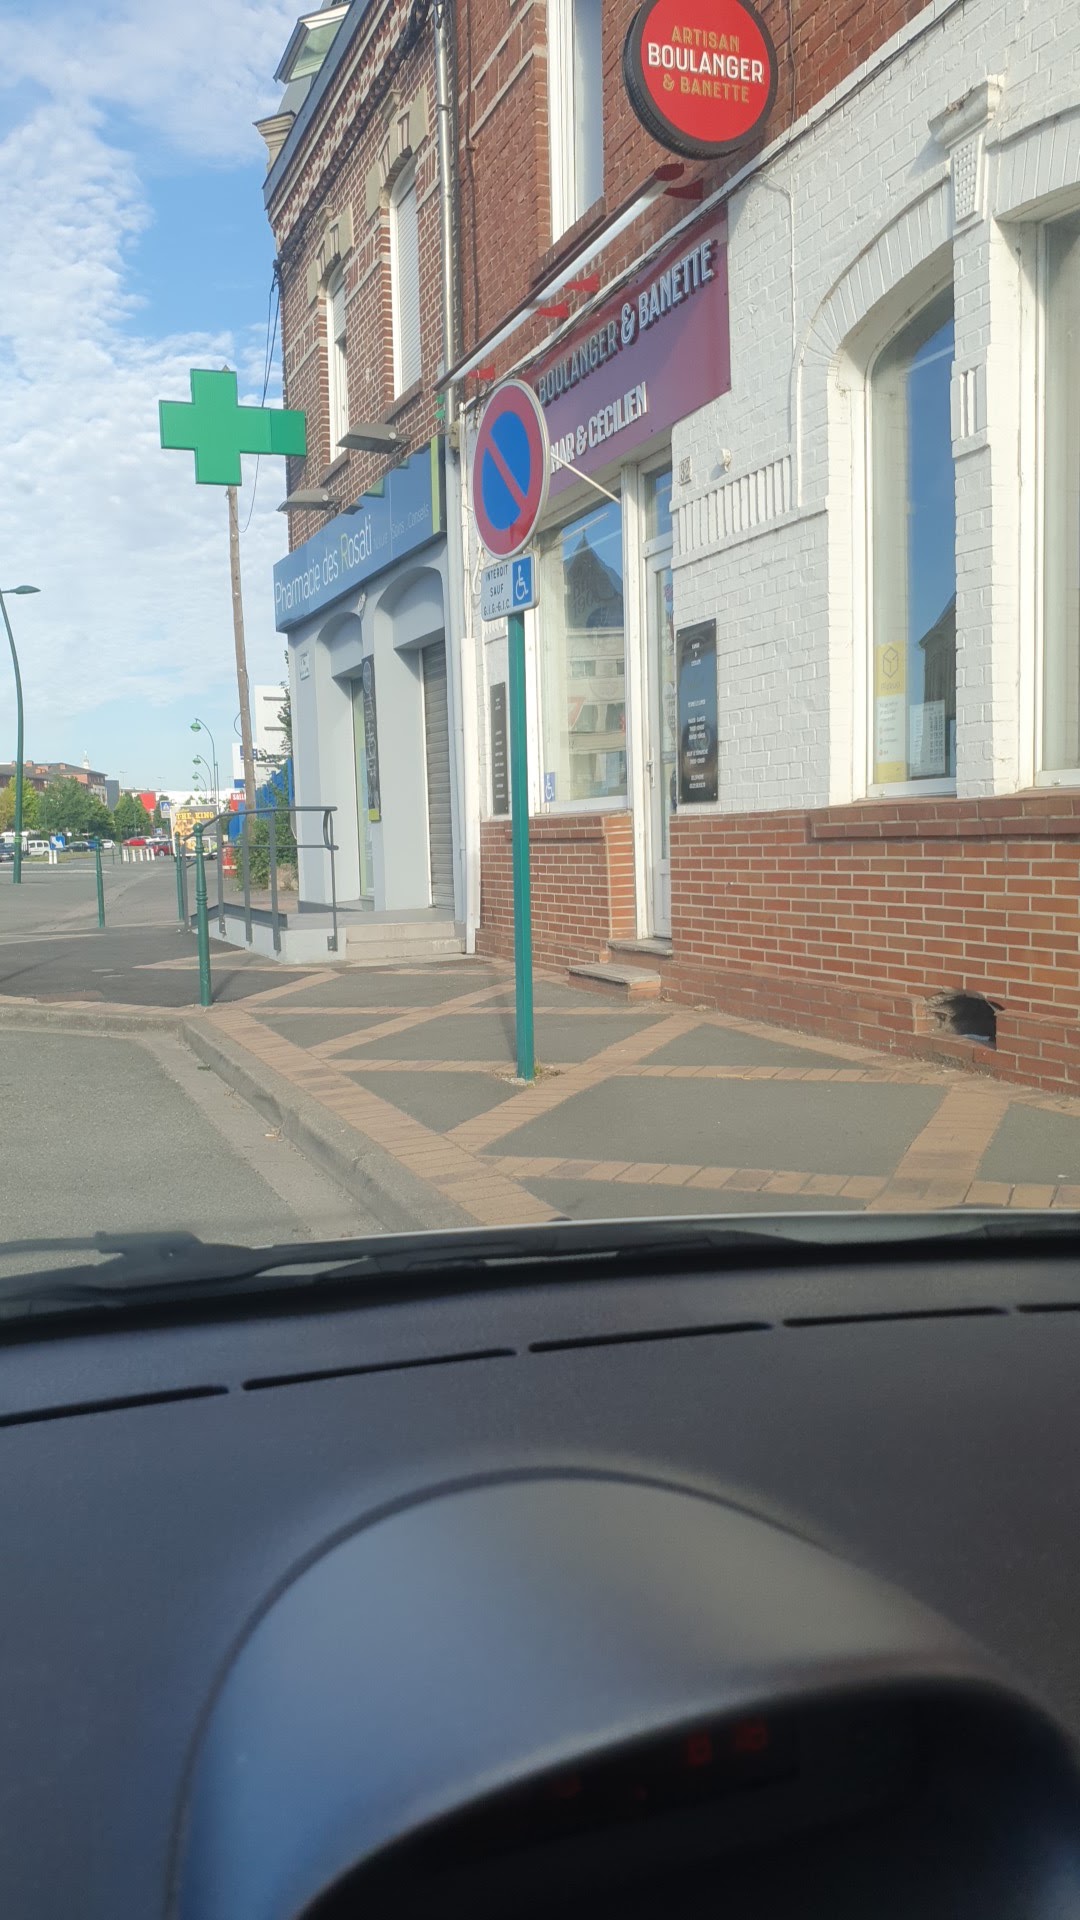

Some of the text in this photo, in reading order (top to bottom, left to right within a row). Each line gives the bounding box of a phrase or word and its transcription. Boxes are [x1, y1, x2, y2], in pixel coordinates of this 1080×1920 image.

[671, 25, 740, 53] ARTISAN
[648, 42, 764, 84] BOULANGER
[662, 73, 749, 103] & BANETTE
[538, 239, 715, 406] BOULANGER & BANETTE
[576, 425, 587, 456] &
[275, 559, 321, 616] Pharmacie
[323, 547, 339, 586] des
[340, 514, 373, 573] Rosati
[486, 564, 509, 582] INTERDIT
[490, 583, 504, 598] SAUF
[176, 811, 214, 820] THE KING
